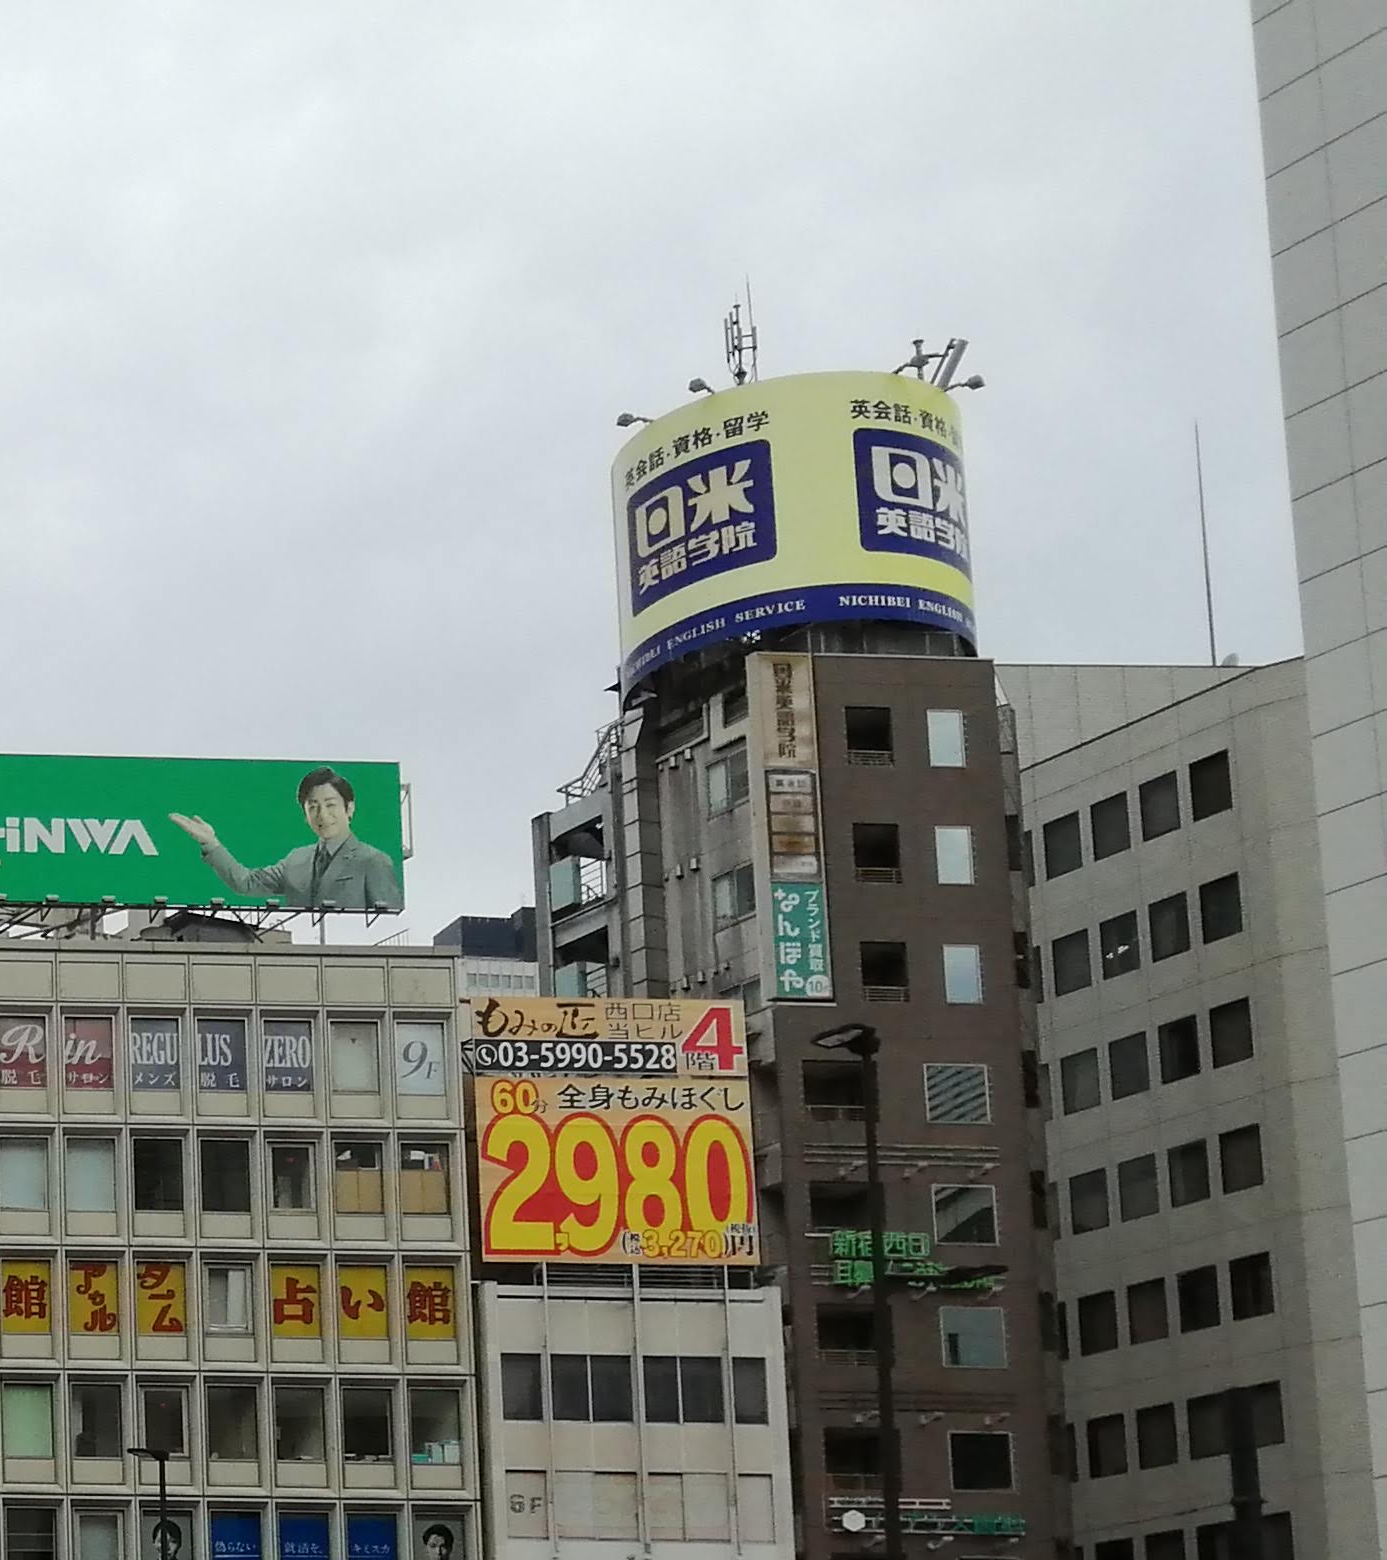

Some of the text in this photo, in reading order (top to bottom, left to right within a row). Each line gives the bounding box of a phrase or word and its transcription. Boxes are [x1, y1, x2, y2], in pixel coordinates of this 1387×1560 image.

[638, 521, 758, 595] 英語学院
[839, 595, 911, 608] NICHIBEI
[667, 599, 806, 650] ENGLISH SERVICE
[774, 888, 805, 994] なんぼや
[605, 1002, 682, 1022] 西口店
[606, 1021, 684, 1039] 当ビル
[264, 1034, 312, 1069] ZERO
[498, 1042, 676, 1070] 03-5990-5528
[681, 1006, 745, 1071] 4
[401, 1039, 440, 1081] 9F
[557, 1083, 746, 1112] 全身もみほぐし
[273, 1278, 452, 1326] 占い館
